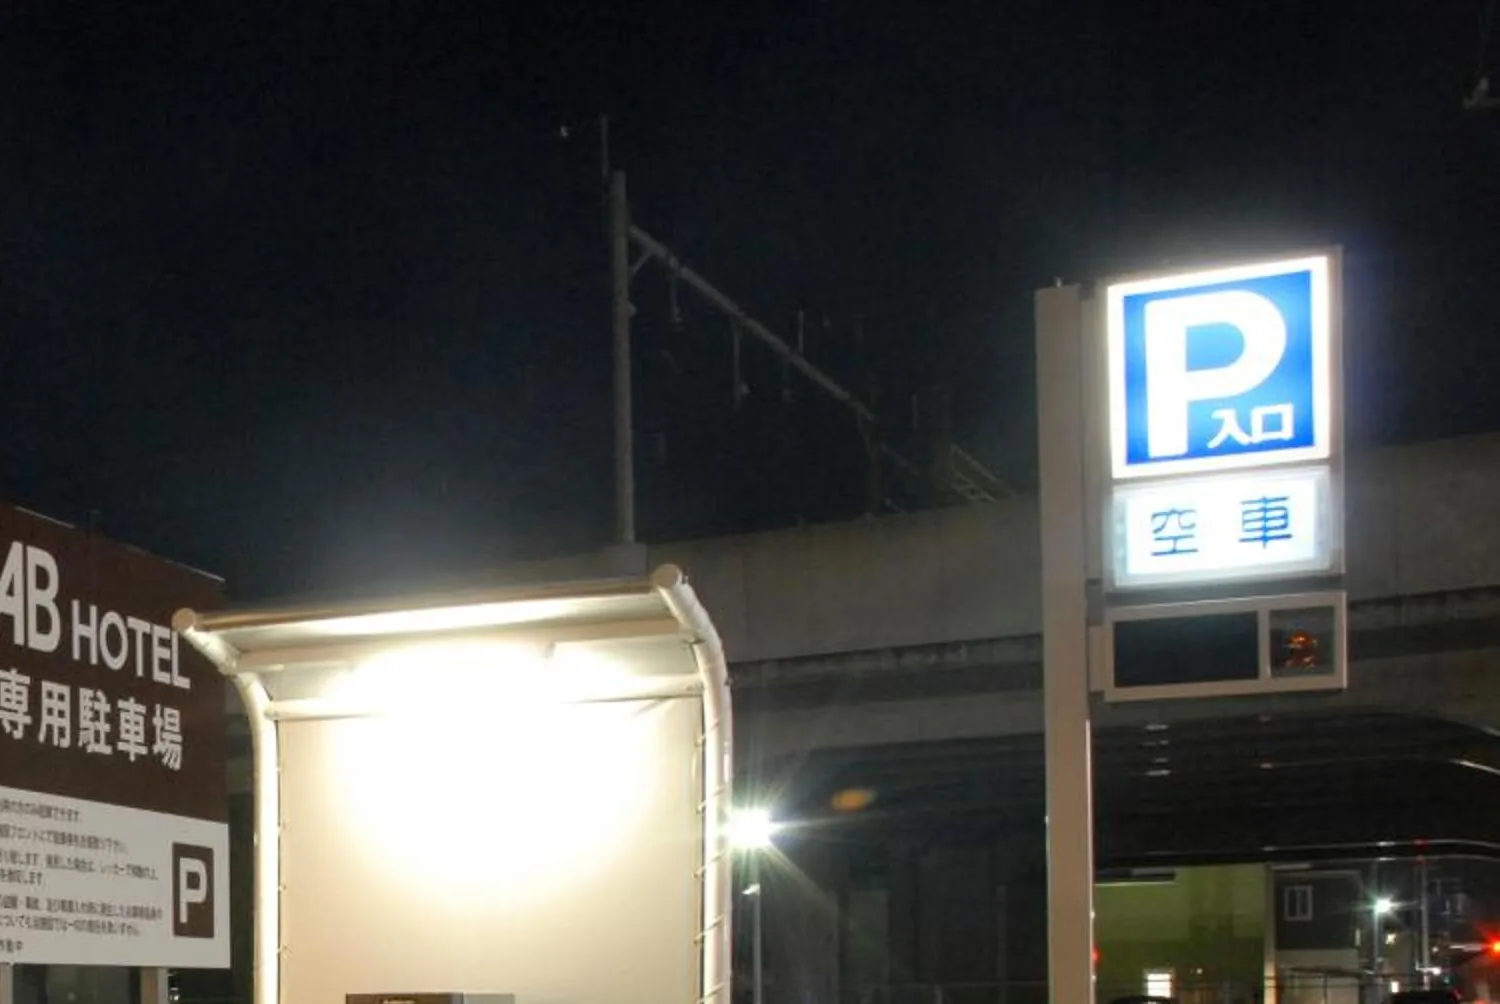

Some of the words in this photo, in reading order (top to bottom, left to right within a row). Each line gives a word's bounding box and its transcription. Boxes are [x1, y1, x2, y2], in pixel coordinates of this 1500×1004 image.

[1144, 289, 1287, 458] P
[1207, 403, 1295, 449] 入口
[1151, 496, 1293, 556] 空車
[71, 599, 191, 690] HOTEL
[179, 856, 208, 923] P
